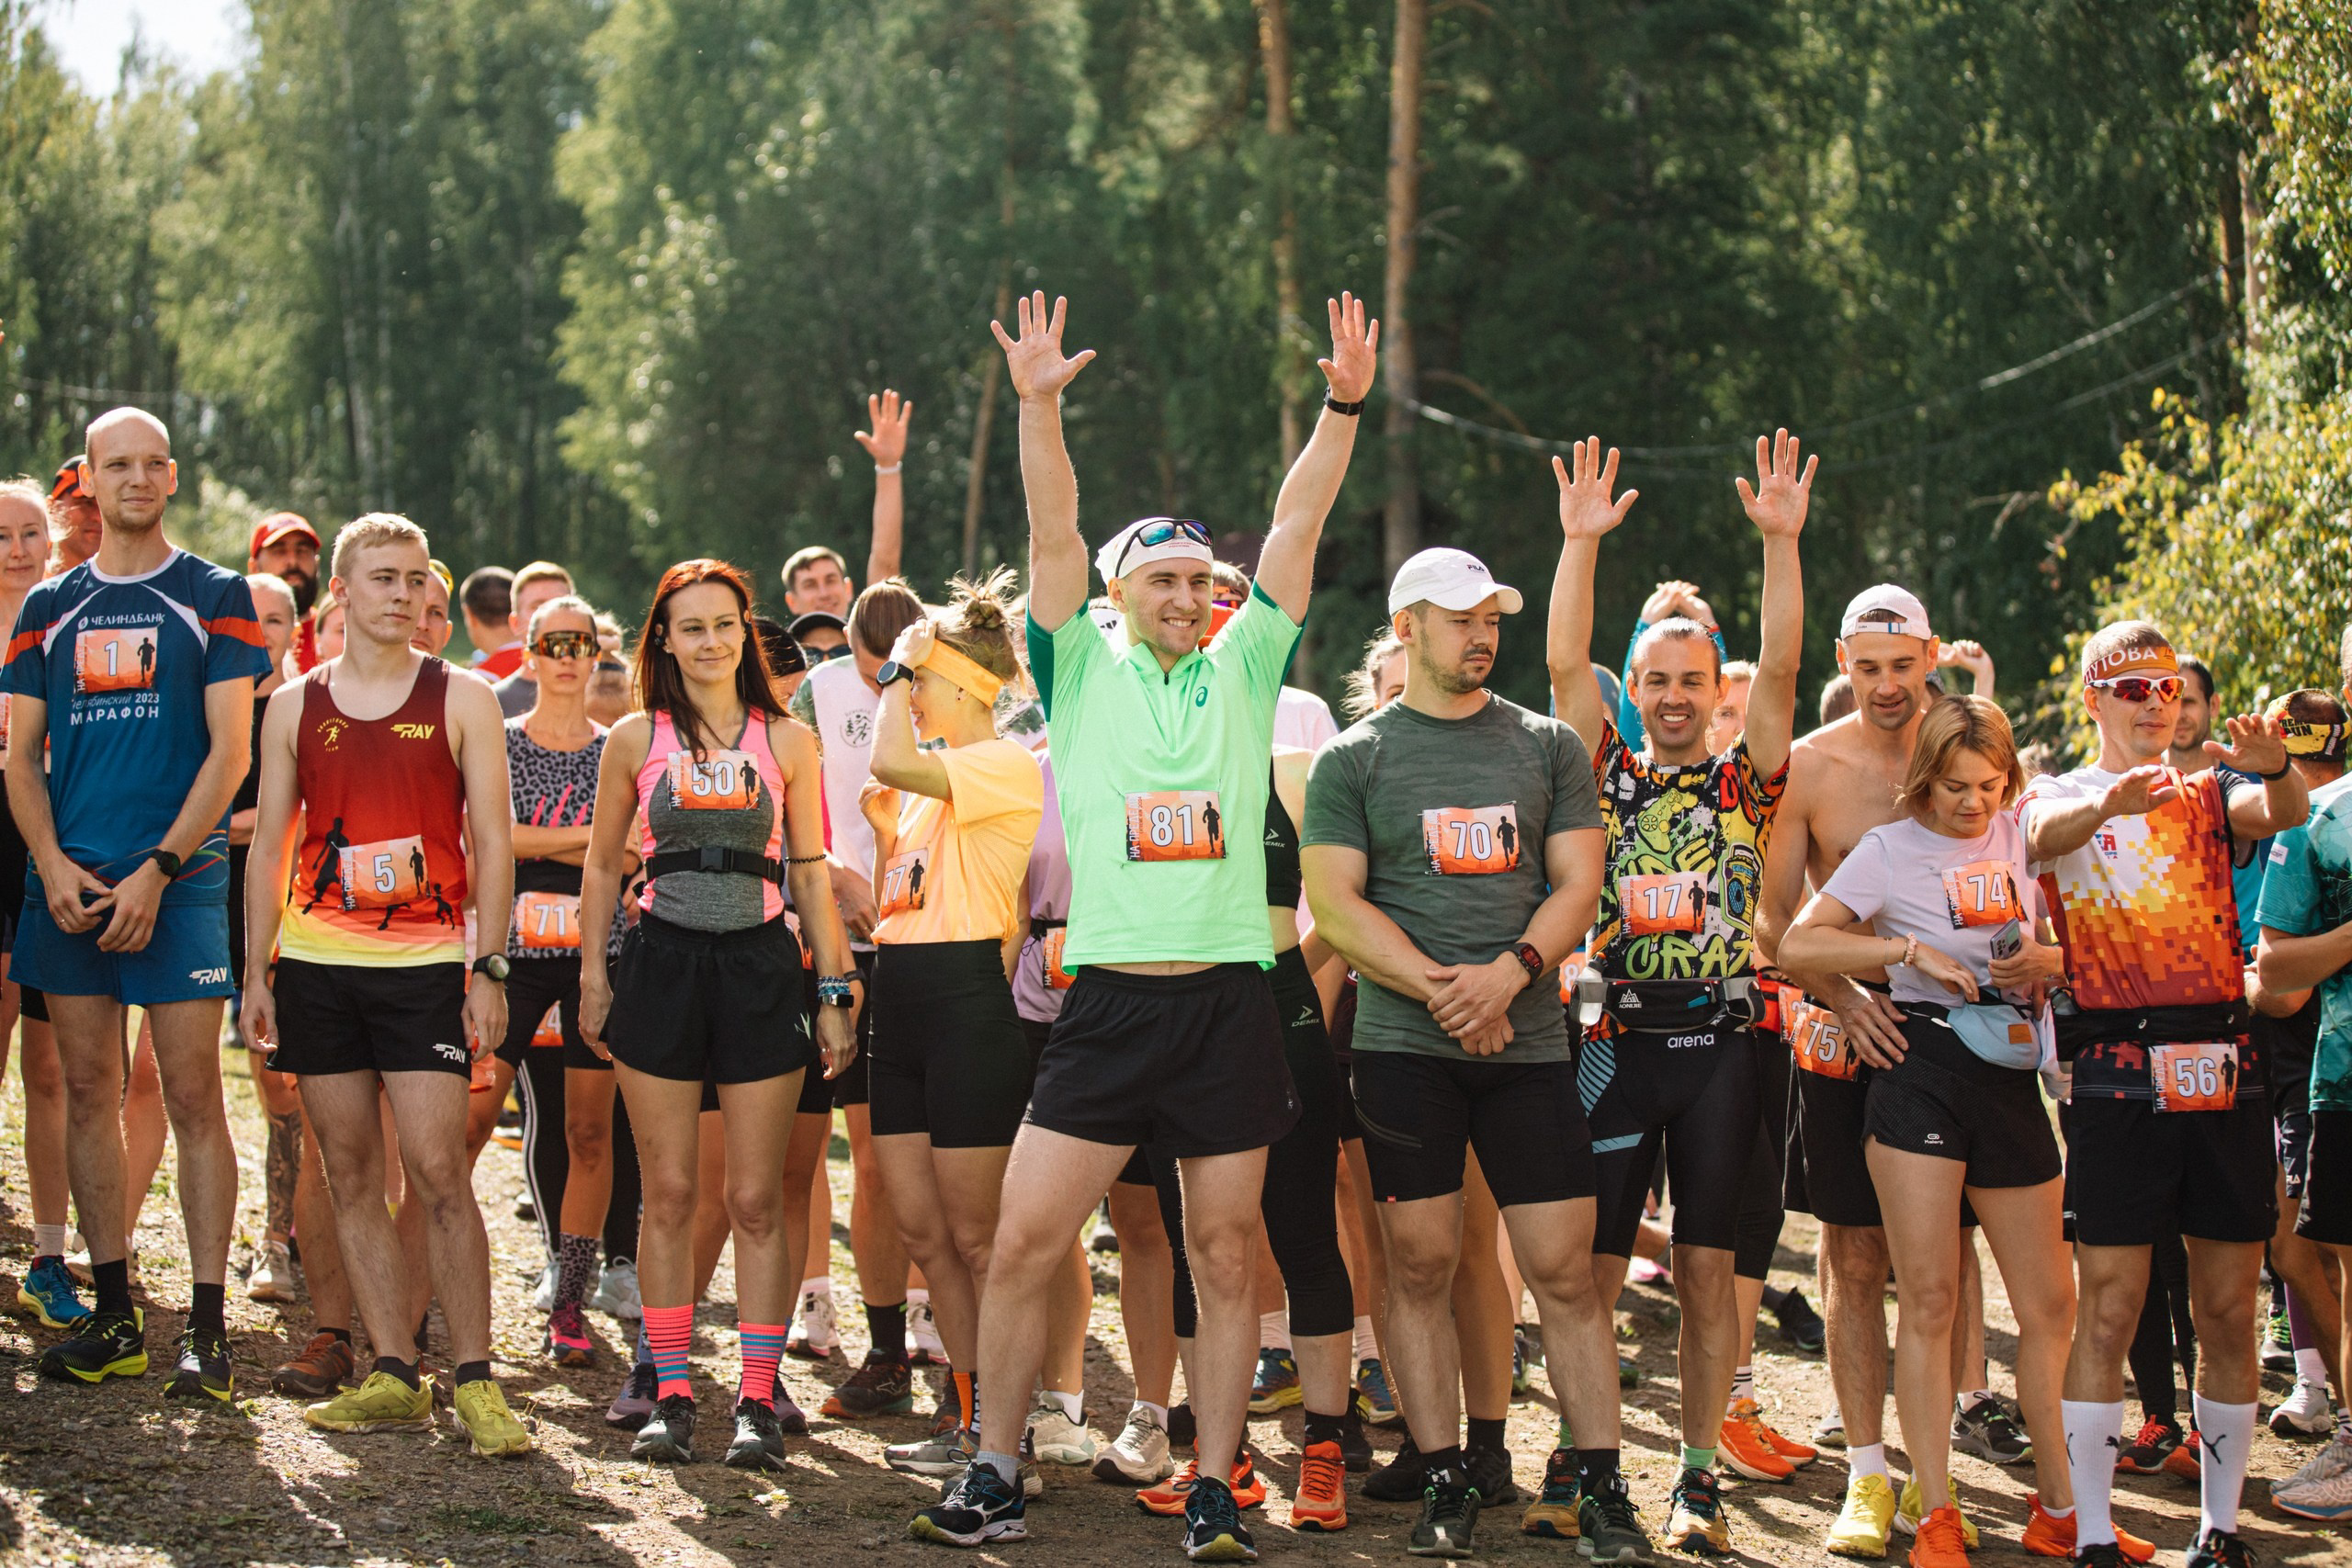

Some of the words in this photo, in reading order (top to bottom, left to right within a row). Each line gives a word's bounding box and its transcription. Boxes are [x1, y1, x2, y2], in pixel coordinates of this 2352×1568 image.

[91, 613, 165, 626] ЧЕЛИНДБАНК
[104, 640, 119, 677] 1
[135, 693, 160, 704] 2023
[71, 706, 159, 726] МАРАФОН
[691, 761, 735, 797] 50
[1150, 805, 1193, 847] 81
[1129, 841, 1140, 858] НА
[1450, 820, 1493, 860] 70
[373, 853, 397, 894] 5
[1431, 858, 1442, 873] НА
[345, 894, 356, 909] НА
[1644, 883, 1682, 919] 17
[1967, 873, 2007, 912] 74
[533, 903, 566, 937] 71
[1622, 921, 1632, 934] НА
[1953, 912, 1964, 926] НА
[1044, 974, 1052, 986] НА
[536, 1005, 562, 1035] 4
[1291, 1018, 1320, 1027] DEMIX
[1668, 1032, 1714, 1049] arena
[1804, 1019, 1841, 1063] 75
[2175, 1056, 2218, 1098] 56
[2156, 1096, 2167, 1110] НА
